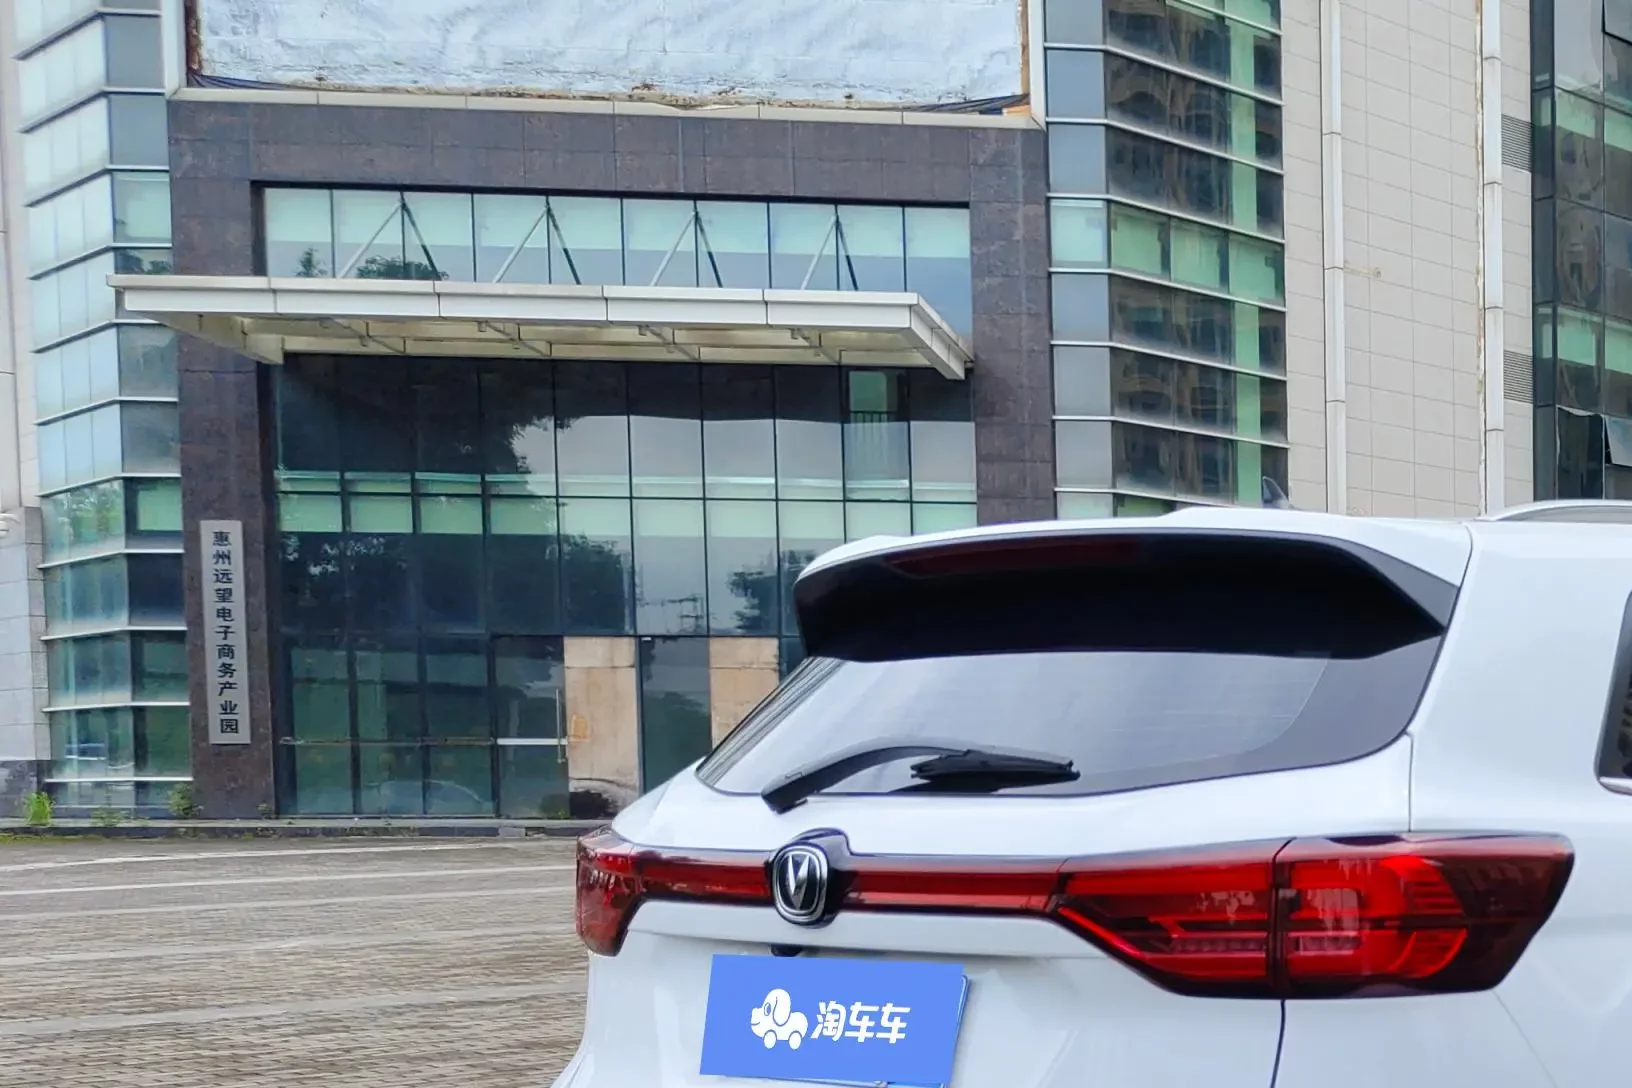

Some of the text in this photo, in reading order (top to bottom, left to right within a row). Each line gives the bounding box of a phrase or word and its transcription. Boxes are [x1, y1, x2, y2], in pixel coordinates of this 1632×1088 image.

[212, 531, 240, 734] 惠州远望电子商务产业园
